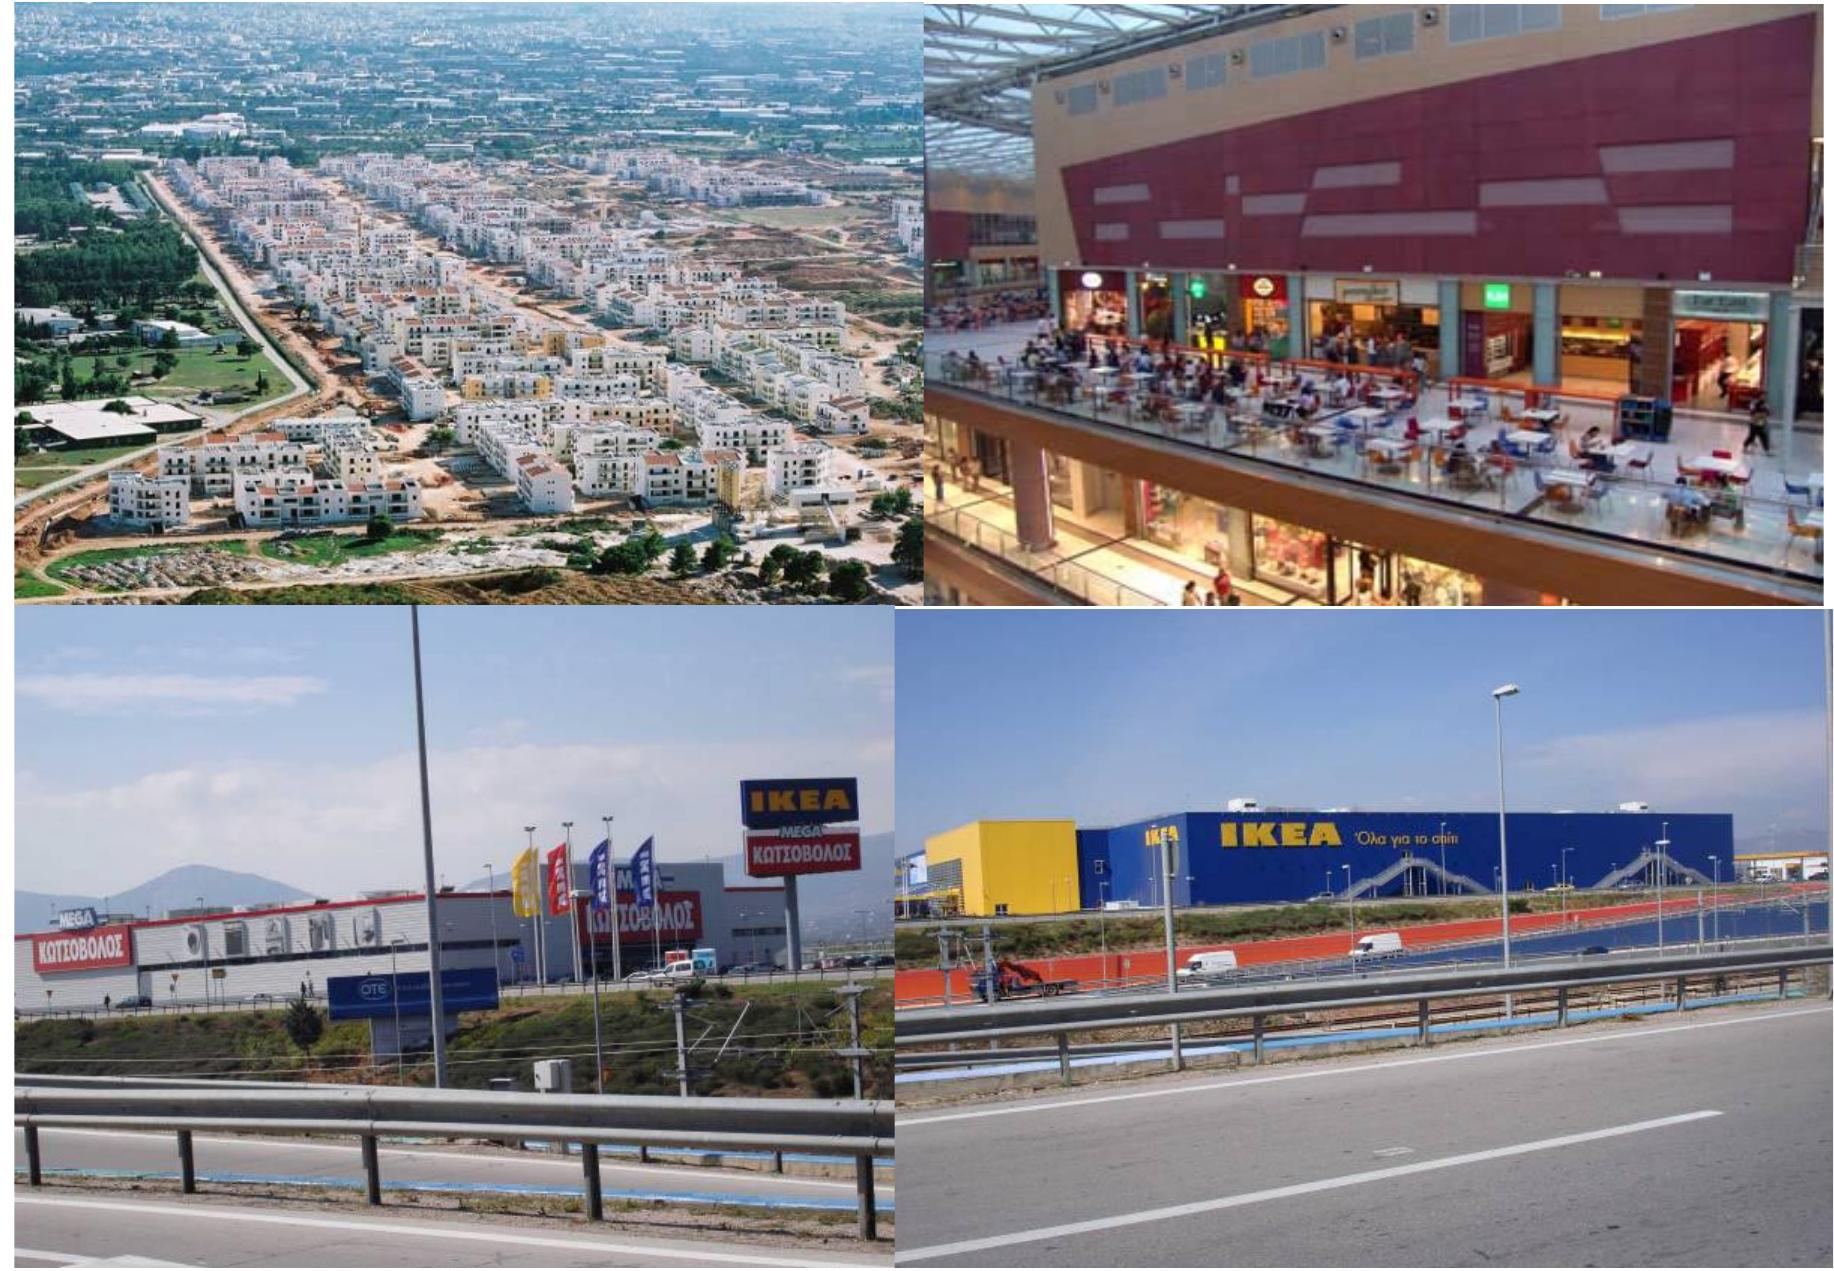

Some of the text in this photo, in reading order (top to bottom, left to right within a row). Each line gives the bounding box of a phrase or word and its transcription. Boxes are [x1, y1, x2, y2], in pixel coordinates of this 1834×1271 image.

[751, 789, 850, 812] IKEA
[780, 825, 822, 838] MEGA
[1220, 822, 1342, 848] IKEA
[1390, 835, 1411, 849] για
[753, 843, 852, 864] ΚΩΤΣΟΒΟΛΟΣ
[60, 910, 94, 928] MEGA
[38, 934, 124, 964] ΚΩΤΣΟΒΟΛΟΣ
